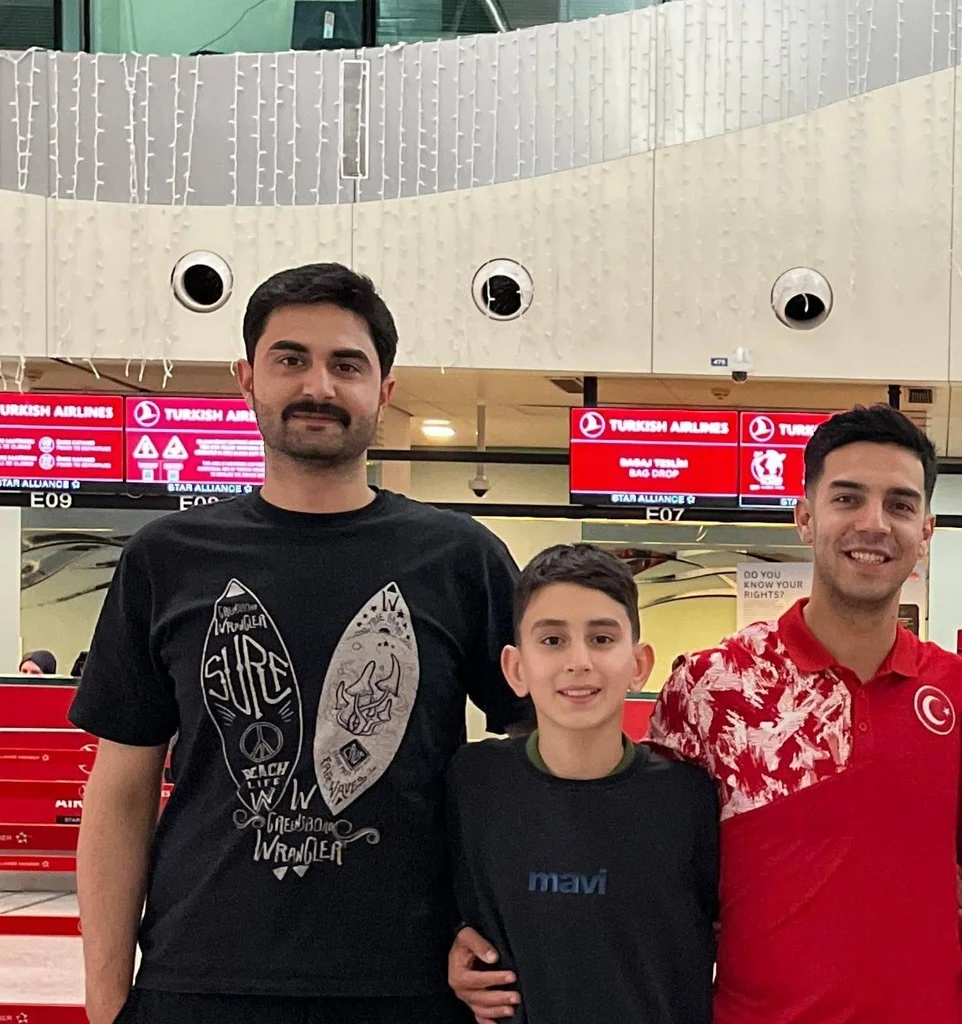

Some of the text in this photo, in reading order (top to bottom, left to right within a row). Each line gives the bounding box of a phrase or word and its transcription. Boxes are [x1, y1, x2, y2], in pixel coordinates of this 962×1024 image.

[0, 404, 114, 419] URKISH AIRLINES
[164, 408, 257, 422] TURKISH AIRL
[610, 419, 729, 434] TURKISH AIRLINES
[779, 423, 819, 436] TURK
[652, 469, 679, 478] DROP
[22, 480, 69, 489] ALLIANCE
[167, 484, 242, 493] STAR ALLIANCE
[30, 492, 72, 508] E09
[611, 494, 685, 504] STAR ALLIANCE
[780, 498, 797, 506] STA
[646, 507, 685, 521] E07
[744, 571, 781, 579] DO YOU
[777, 581, 803, 589] YOUR
[241, 761, 290, 780] BEACH
[247, 777, 280, 789] LIFE
[528, 868, 607, 895] mavi
